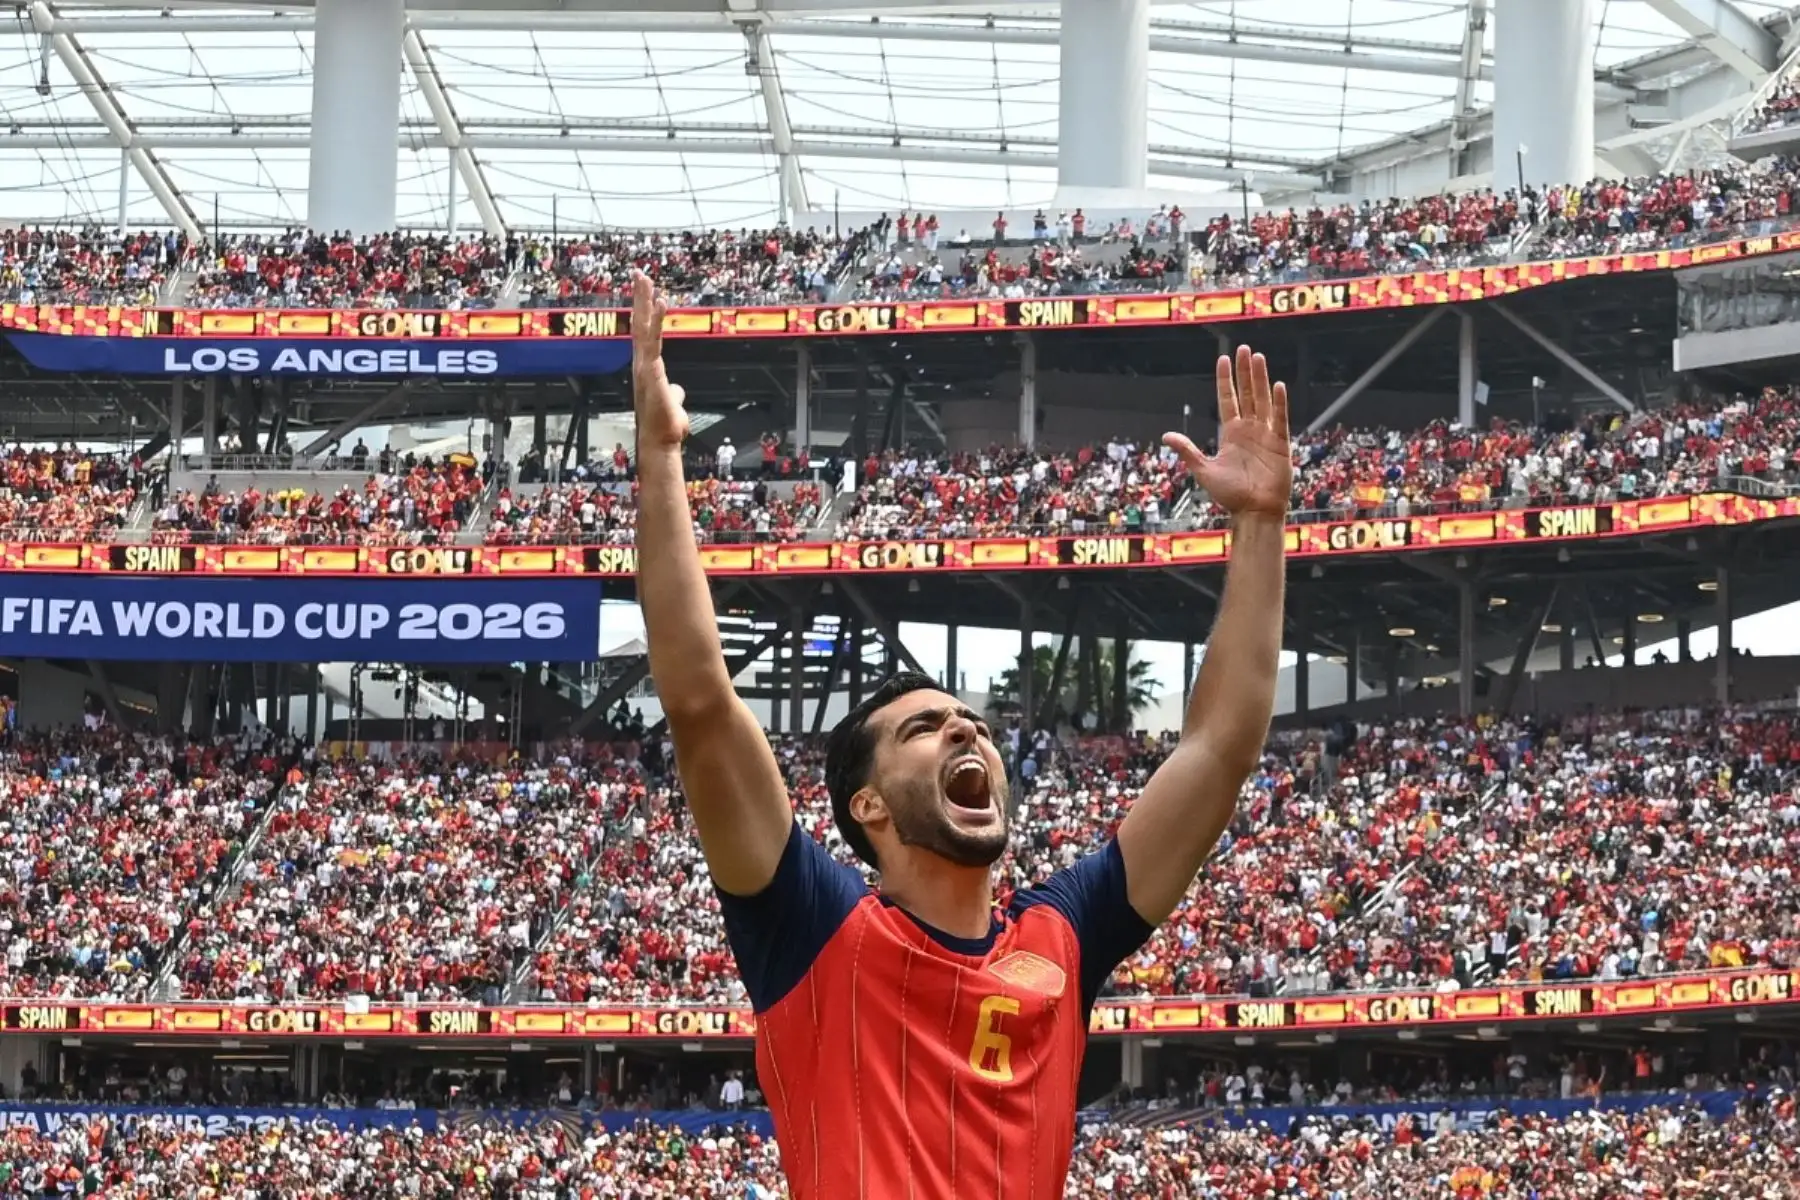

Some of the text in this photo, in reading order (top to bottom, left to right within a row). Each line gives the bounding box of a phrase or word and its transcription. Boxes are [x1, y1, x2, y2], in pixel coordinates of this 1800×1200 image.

[1273, 285, 1345, 312] GOAL!
[362, 311, 434, 337] GOAL!
[563, 312, 616, 336] SPAIN
[818, 307, 890, 332] GOAL!
[1019, 301, 1073, 326] SPAIN
[164, 348, 498, 374] LOS ANGELES
[1331, 521, 1406, 549] GOAL!
[1540, 508, 1596, 537] SPAIN
[125, 546, 180, 572] SPAIN
[390, 547, 465, 573] GOAL!
[863, 542, 938, 569] GOAL!
[1073, 538, 1129, 565] SPAIN
[2, 598, 565, 640] FIFA WORLD CUP 2026
[1732, 975, 1788, 1001] GOAL!
[1238, 1003, 1285, 1027] SPAIN
[1370, 997, 1430, 1021] GOAL!
[1535, 989, 1581, 1015] SPAIN
[19, 1007, 67, 1029] SPAIN
[250, 1009, 315, 1032] GOAL!
[430, 1011, 478, 1033] SPAIN
[659, 1011, 725, 1034] GOAL!
[970, 995, 1020, 1082] 6
